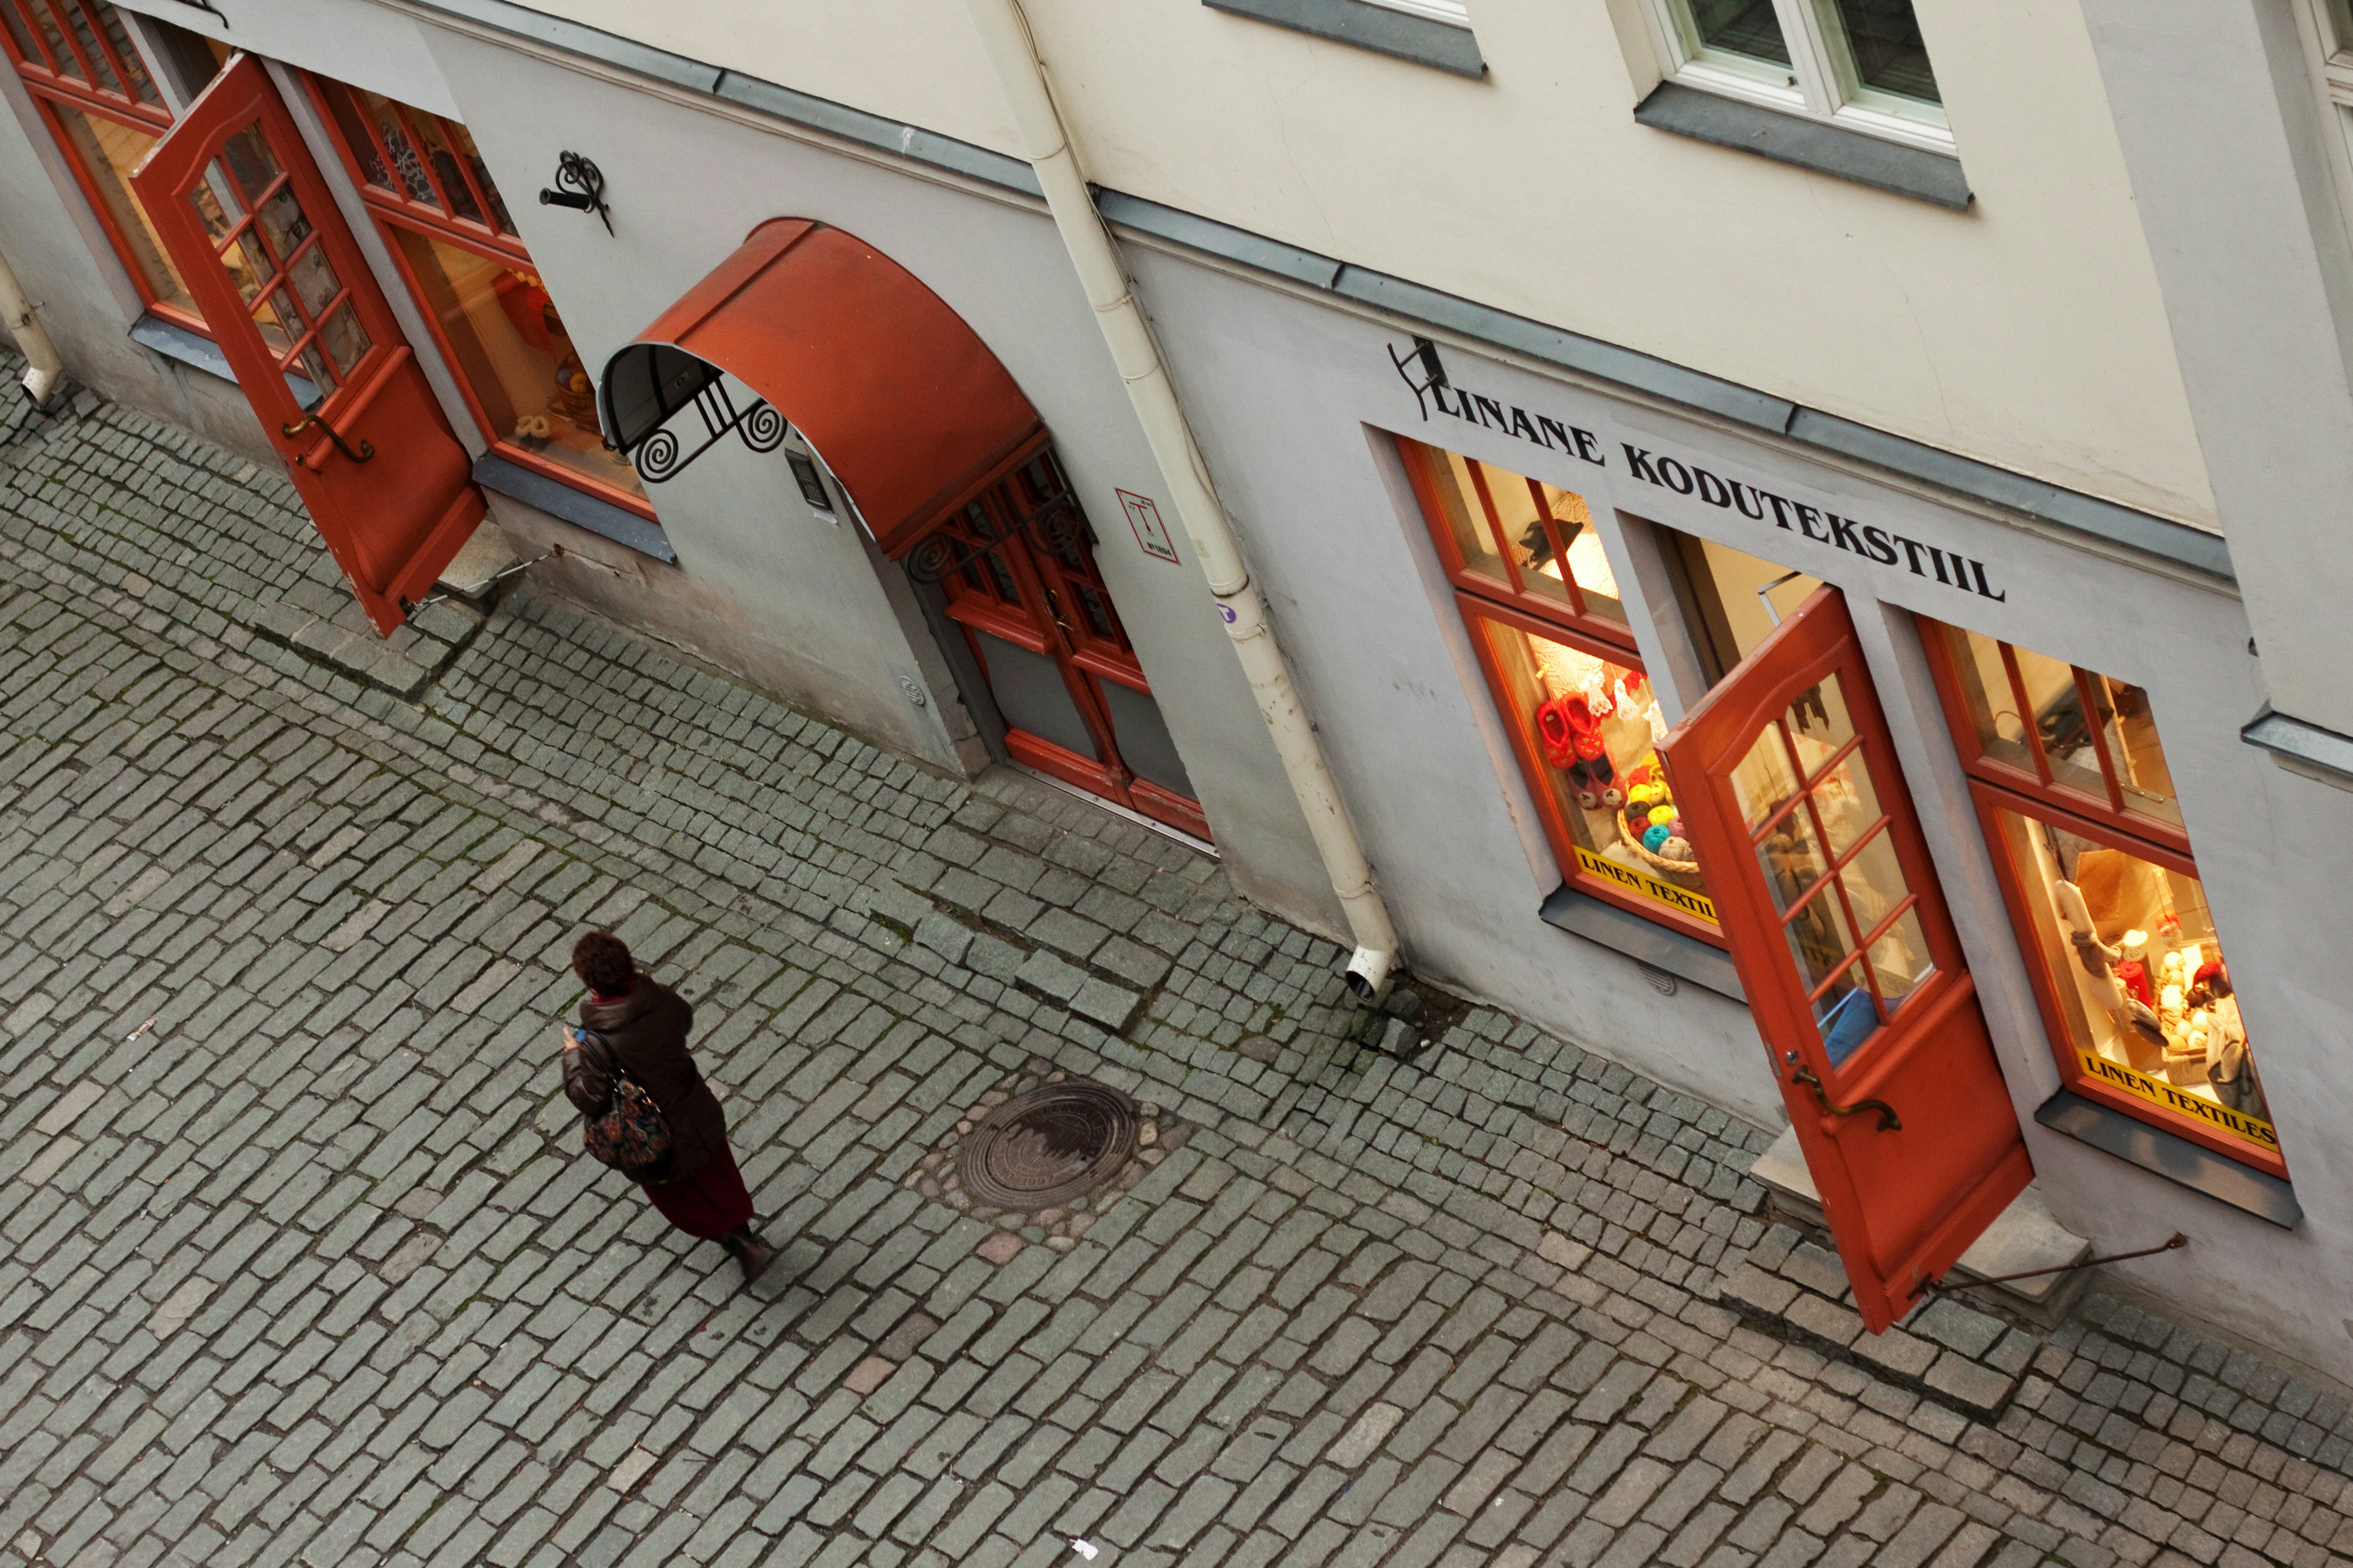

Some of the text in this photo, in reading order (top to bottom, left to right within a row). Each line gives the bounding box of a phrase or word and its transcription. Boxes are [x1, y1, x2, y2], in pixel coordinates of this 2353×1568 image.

[1425, 376, 2006, 602] LINANE KODUTEKSTIIL
[1580, 854, 1642, 889] LINEN
[2086, 1056, 2276, 1144] LINEN TEXTILES
